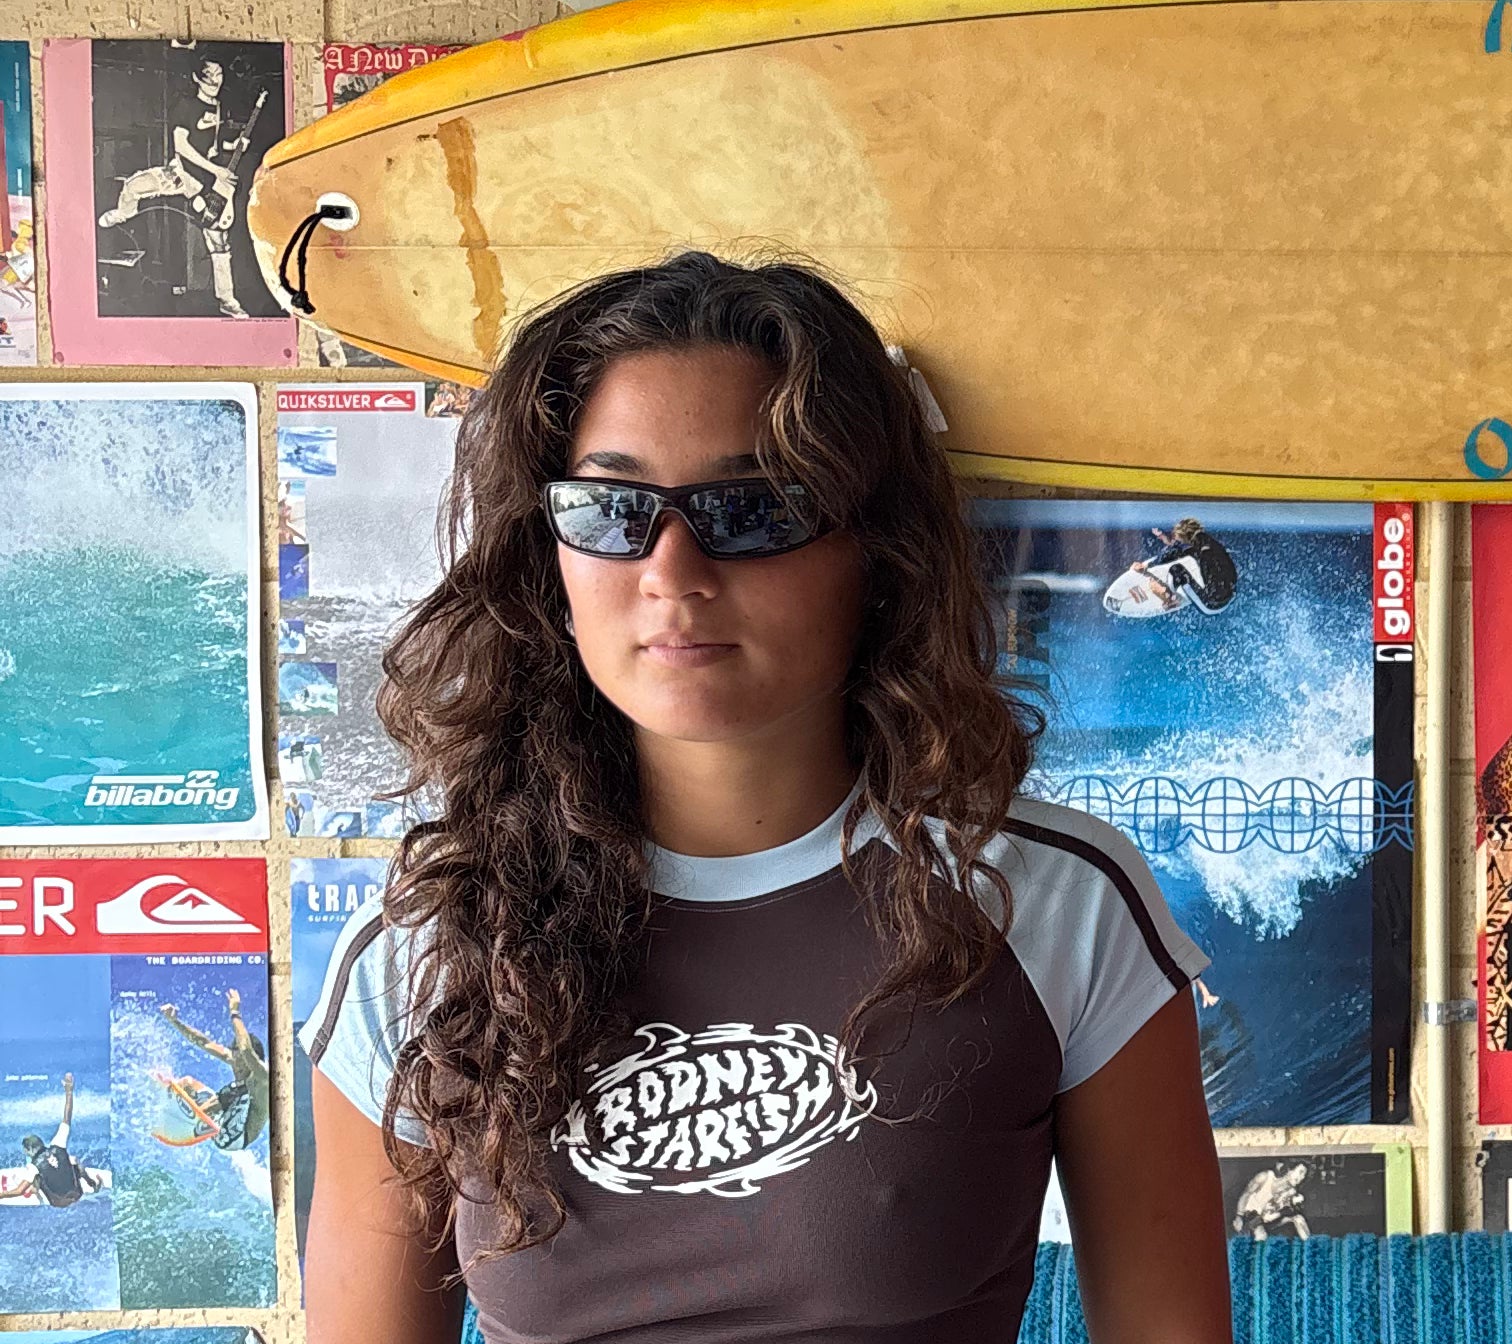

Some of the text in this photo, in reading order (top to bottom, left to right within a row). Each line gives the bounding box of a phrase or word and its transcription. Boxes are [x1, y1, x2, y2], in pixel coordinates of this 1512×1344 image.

[324, 47, 344, 70] A
[346, 47, 403, 72] New
[278, 394, 371, 410] QUIKSILVER
[1377, 516, 1411, 637] globe
[84, 784, 240, 811] billabong
[594, 1046, 808, 1143] RODNEY
[599, 1060, 835, 1172] STARFISH
